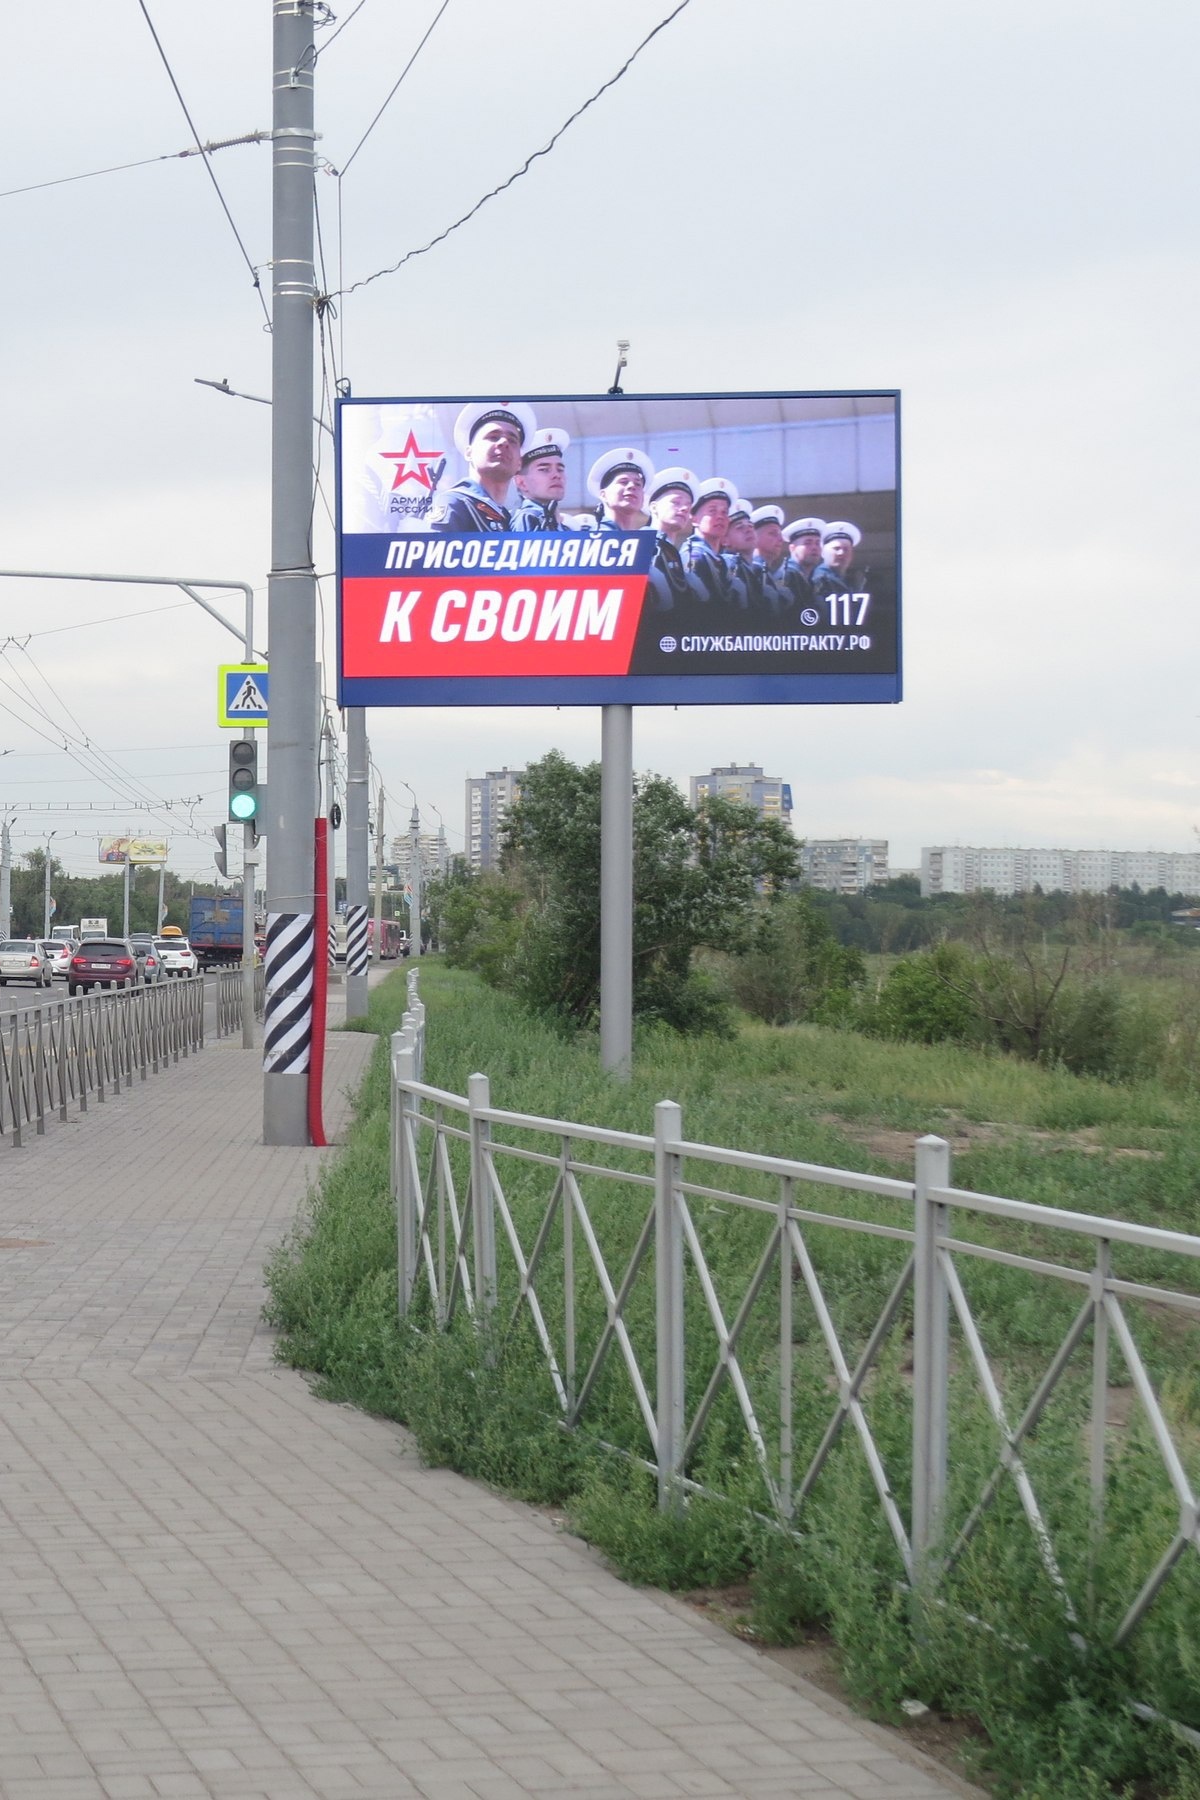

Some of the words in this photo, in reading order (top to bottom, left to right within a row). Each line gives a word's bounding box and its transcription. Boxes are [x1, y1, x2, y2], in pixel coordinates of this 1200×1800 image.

[390, 506, 433, 514] РОССИИ
[391, 497, 433, 505] АРМИЯ
[384, 532, 639, 570] ПРИСОЕДИНЯЙСЯ
[379, 590, 422, 642] К
[430, 589, 624, 642] СВОИМ
[825, 593, 870, 626] 117
[681, 635, 871, 652] СЛУЖБАПОКОНТРАКТУ.РФ
